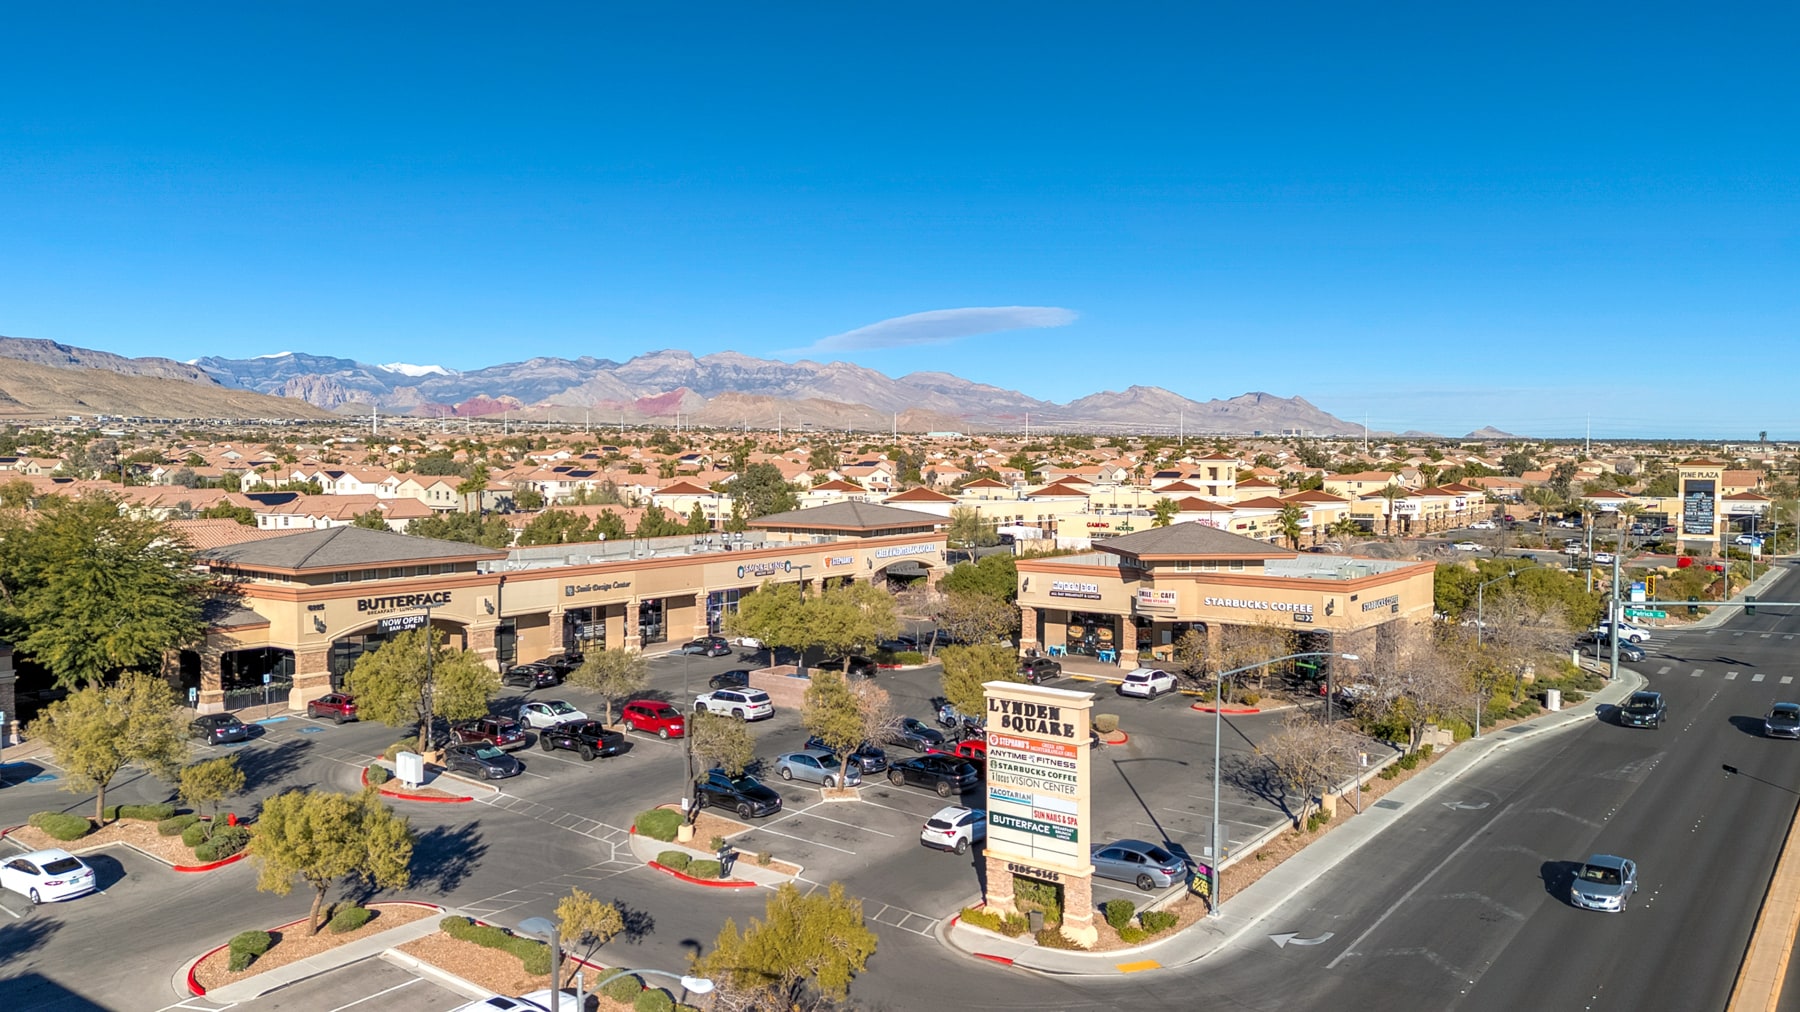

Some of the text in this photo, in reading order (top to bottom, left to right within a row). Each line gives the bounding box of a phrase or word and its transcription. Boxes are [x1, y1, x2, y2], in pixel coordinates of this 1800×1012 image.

[769, 560, 785, 571] KING
[357, 592, 451, 611] BUTTERFACE
[367, 607, 396, 615] BREAKFAST
[1204, 596, 1313, 613] STARBUCKS COFFEE
[382, 615, 424, 627] NOW OPEN
[989, 698, 1061, 720] LYNDEN
[1001, 715, 1074, 738] SQUARE
[990, 749, 1076, 769] ANYTIME FITNESS
[998, 762, 1077, 782] STARBUCKS COFFEE
[990, 787, 1031, 800] TACOTARIAN
[1011, 776, 1040, 788] VISION
[1043, 781, 1075, 795] CENTER
[993, 814, 1050, 834] BUTTERFACE
[1033, 810, 1078, 826] SUN NAILS & SPA
